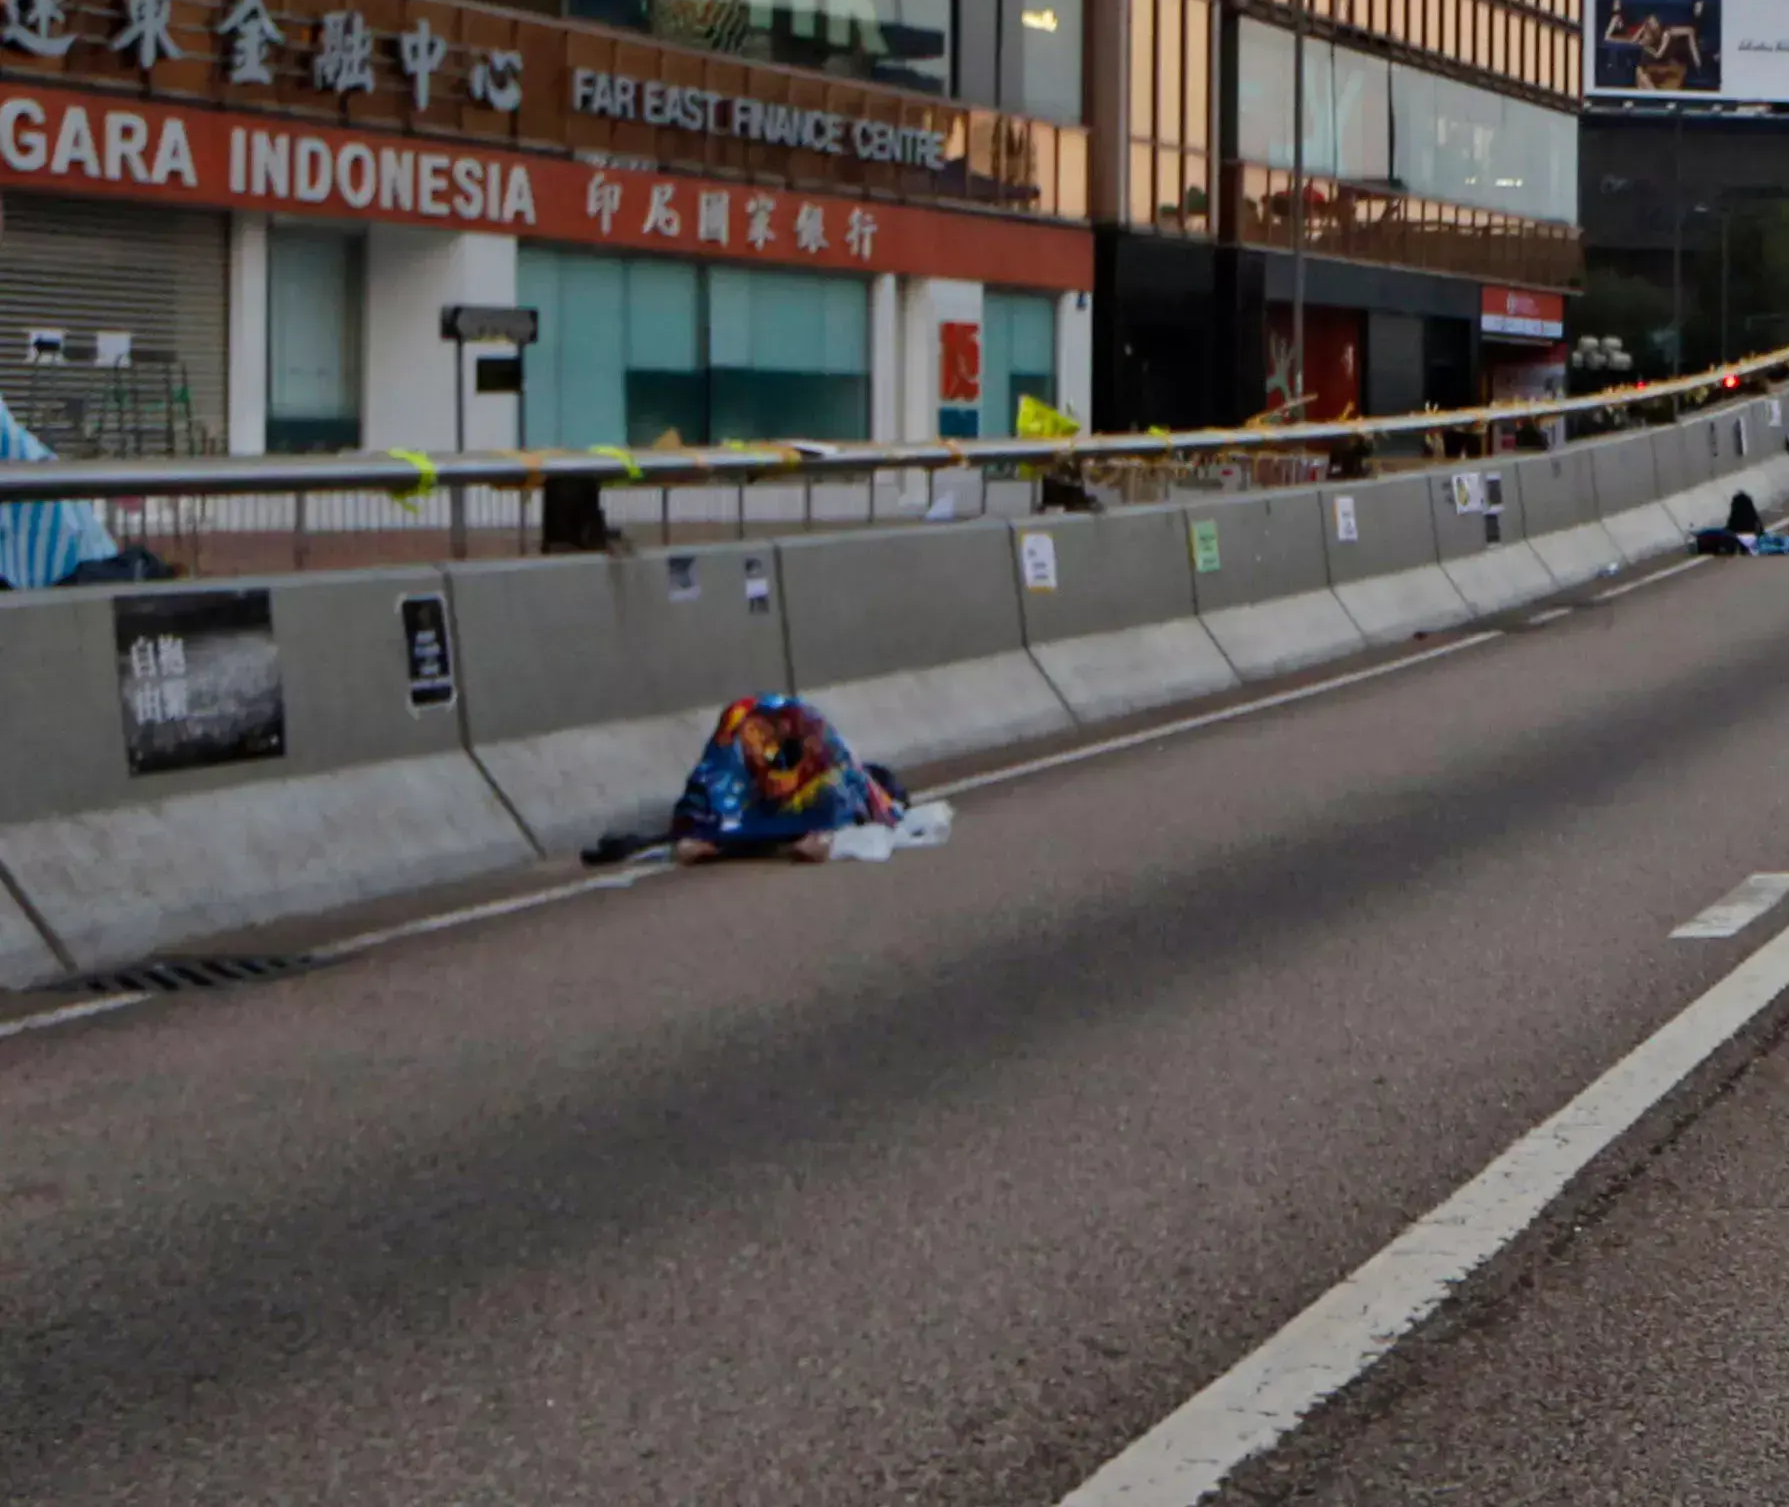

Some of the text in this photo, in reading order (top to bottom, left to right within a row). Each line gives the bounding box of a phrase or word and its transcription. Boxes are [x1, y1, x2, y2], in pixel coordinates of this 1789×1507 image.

[0, 98, 537, 225] GARA INDONESIA
[573, 66, 946, 170] FAR EAST FINANCE CENTRE
